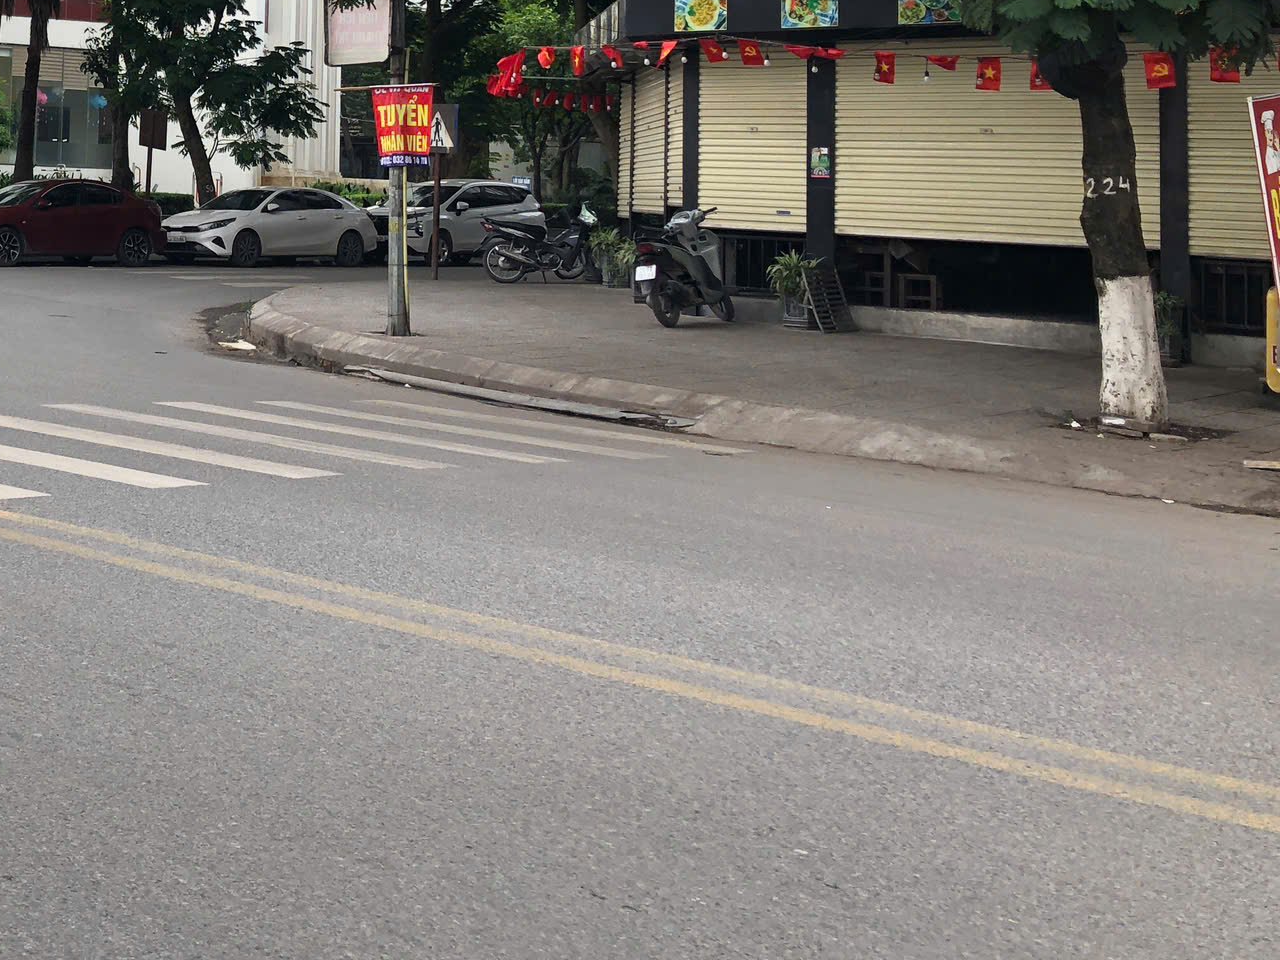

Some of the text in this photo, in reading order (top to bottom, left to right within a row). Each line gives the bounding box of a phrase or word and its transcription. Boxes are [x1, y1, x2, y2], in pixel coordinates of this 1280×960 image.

[377, 95, 429, 127] TUYỂN
[380, 130, 428, 153] NHÂN VIÊN
[1086, 175, 1130, 199] 224
